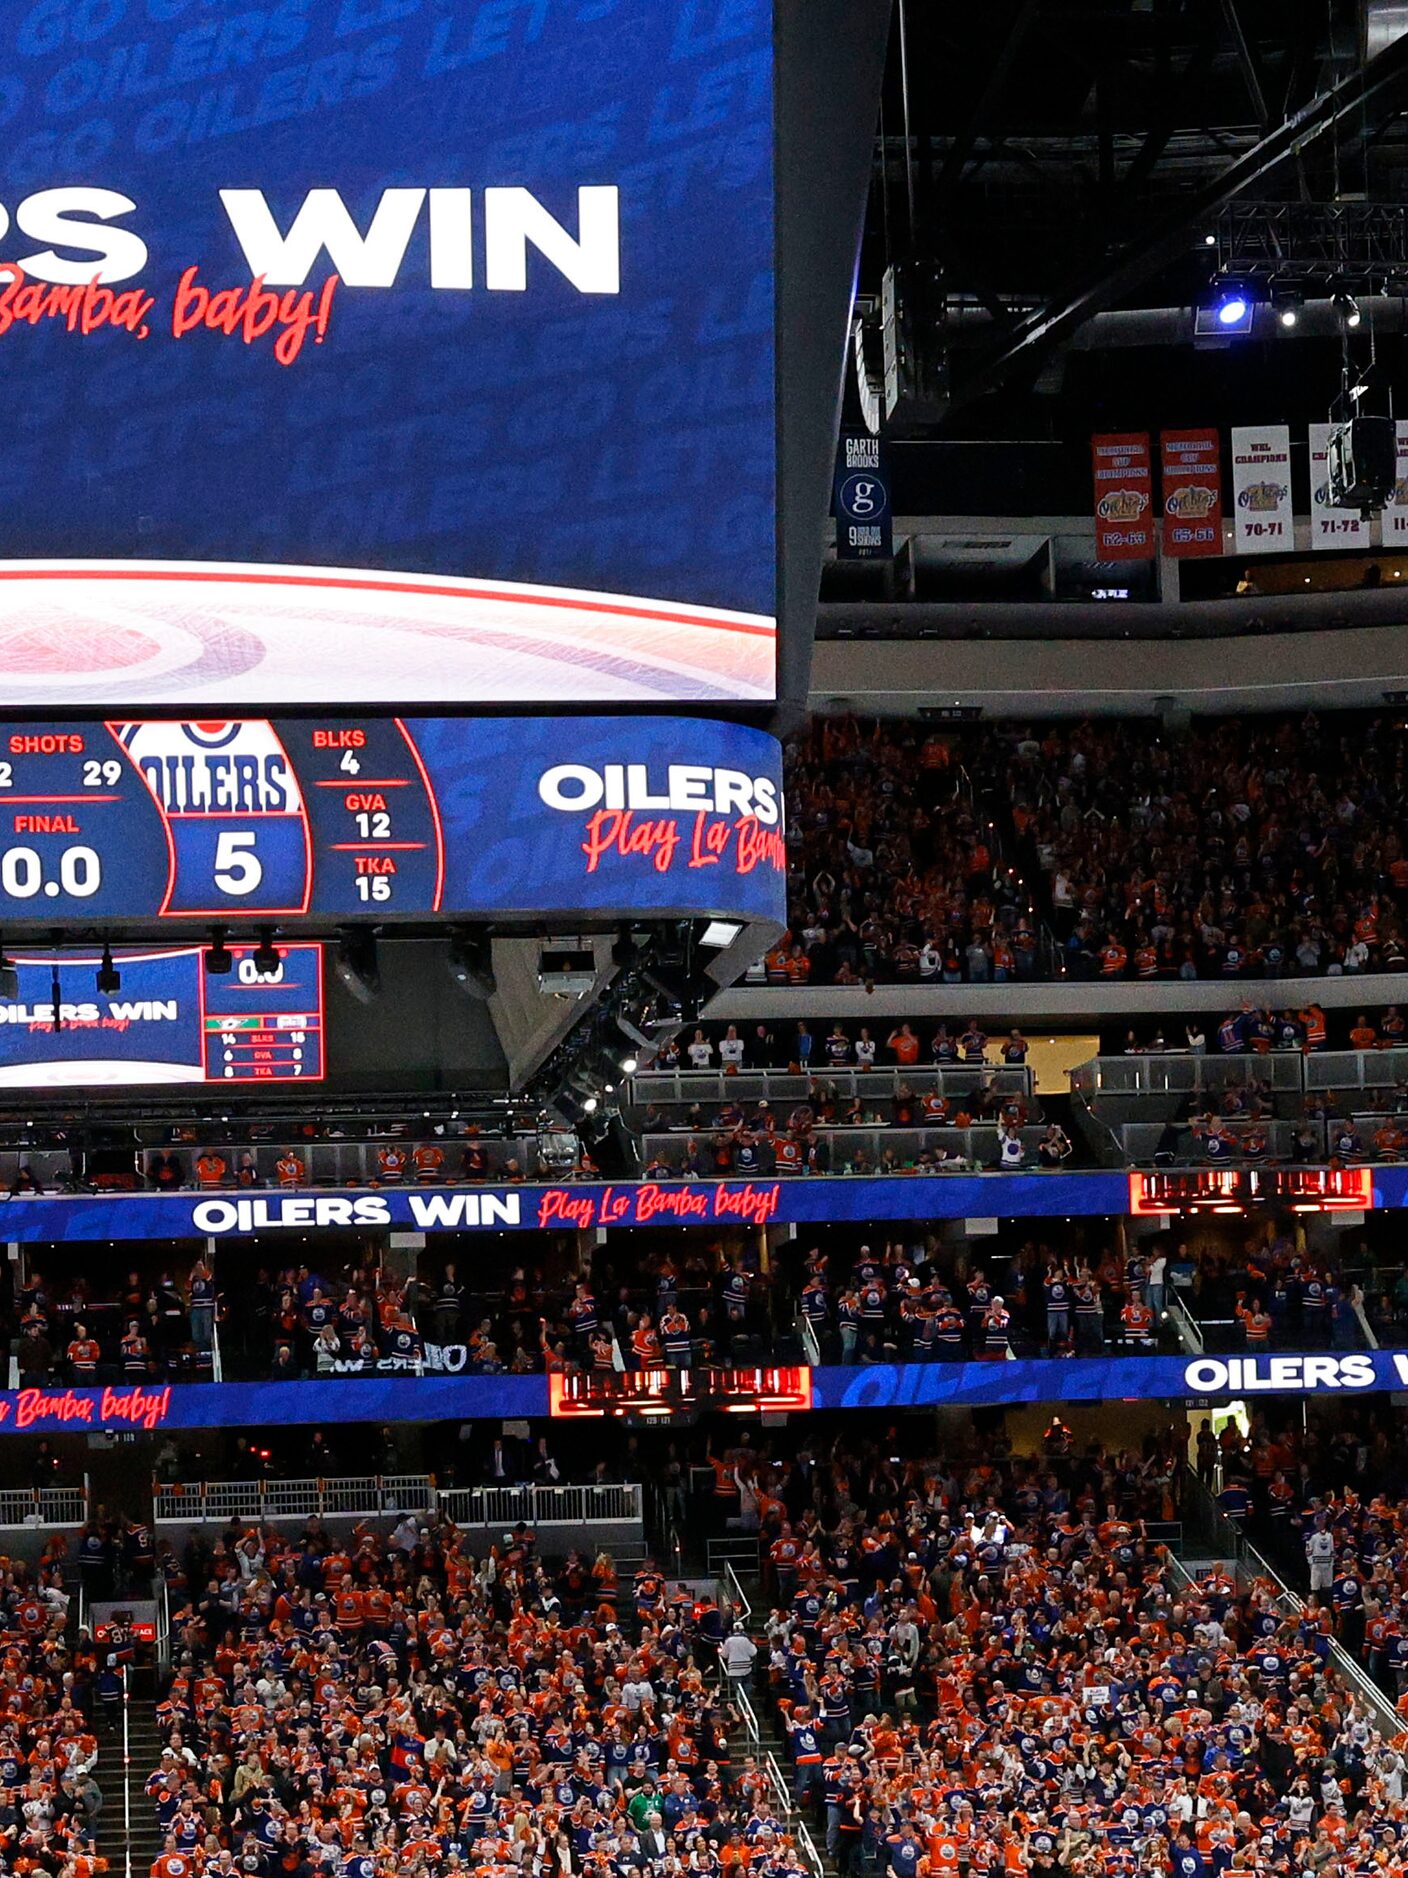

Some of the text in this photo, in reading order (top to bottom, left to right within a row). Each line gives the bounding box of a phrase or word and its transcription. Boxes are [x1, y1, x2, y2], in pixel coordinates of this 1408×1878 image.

[218, 185, 620, 294] WIN
[171, 265, 341, 367] baby!
[846, 438, 880, 455] GARTH
[846, 454, 880, 468] BROOKS
[1245, 522, 1283, 536] 70-71
[1320, 519, 1360, 533] 71-72
[8, 734, 85, 754] SHOTS
[312, 729, 366, 748] BLKS
[83, 760, 122, 787] 29
[340, 749, 361, 776] 4
[139, 754, 287, 812] OILERS
[538, 764, 779, 825] OILERS
[345, 793, 387, 812] GVA
[14, 815, 80, 834] FINAL
[355, 812, 392, 838] 12
[581, 809, 681, 873] Play
[688, 810, 732, 868] La
[1, 846, 101, 898] 0.0
[214, 831, 263, 895] 5
[354, 857, 396, 875] TKA
[355, 875, 392, 902] 15
[108, 1000, 178, 1022] WIN
[192, 1197, 391, 1232] OILERS
[408, 1193, 521, 1228] WIN
[537, 1190, 596, 1229] Play
[598, 1187, 631, 1223] La
[635, 1183, 709, 1222] Bamba,
[713, 1182, 780, 1225] baby!
[1185, 1355, 1376, 1391] OILERS
[15, 1388, 95, 1428] Bamba,
[100, 1386, 172, 1429] baby!
